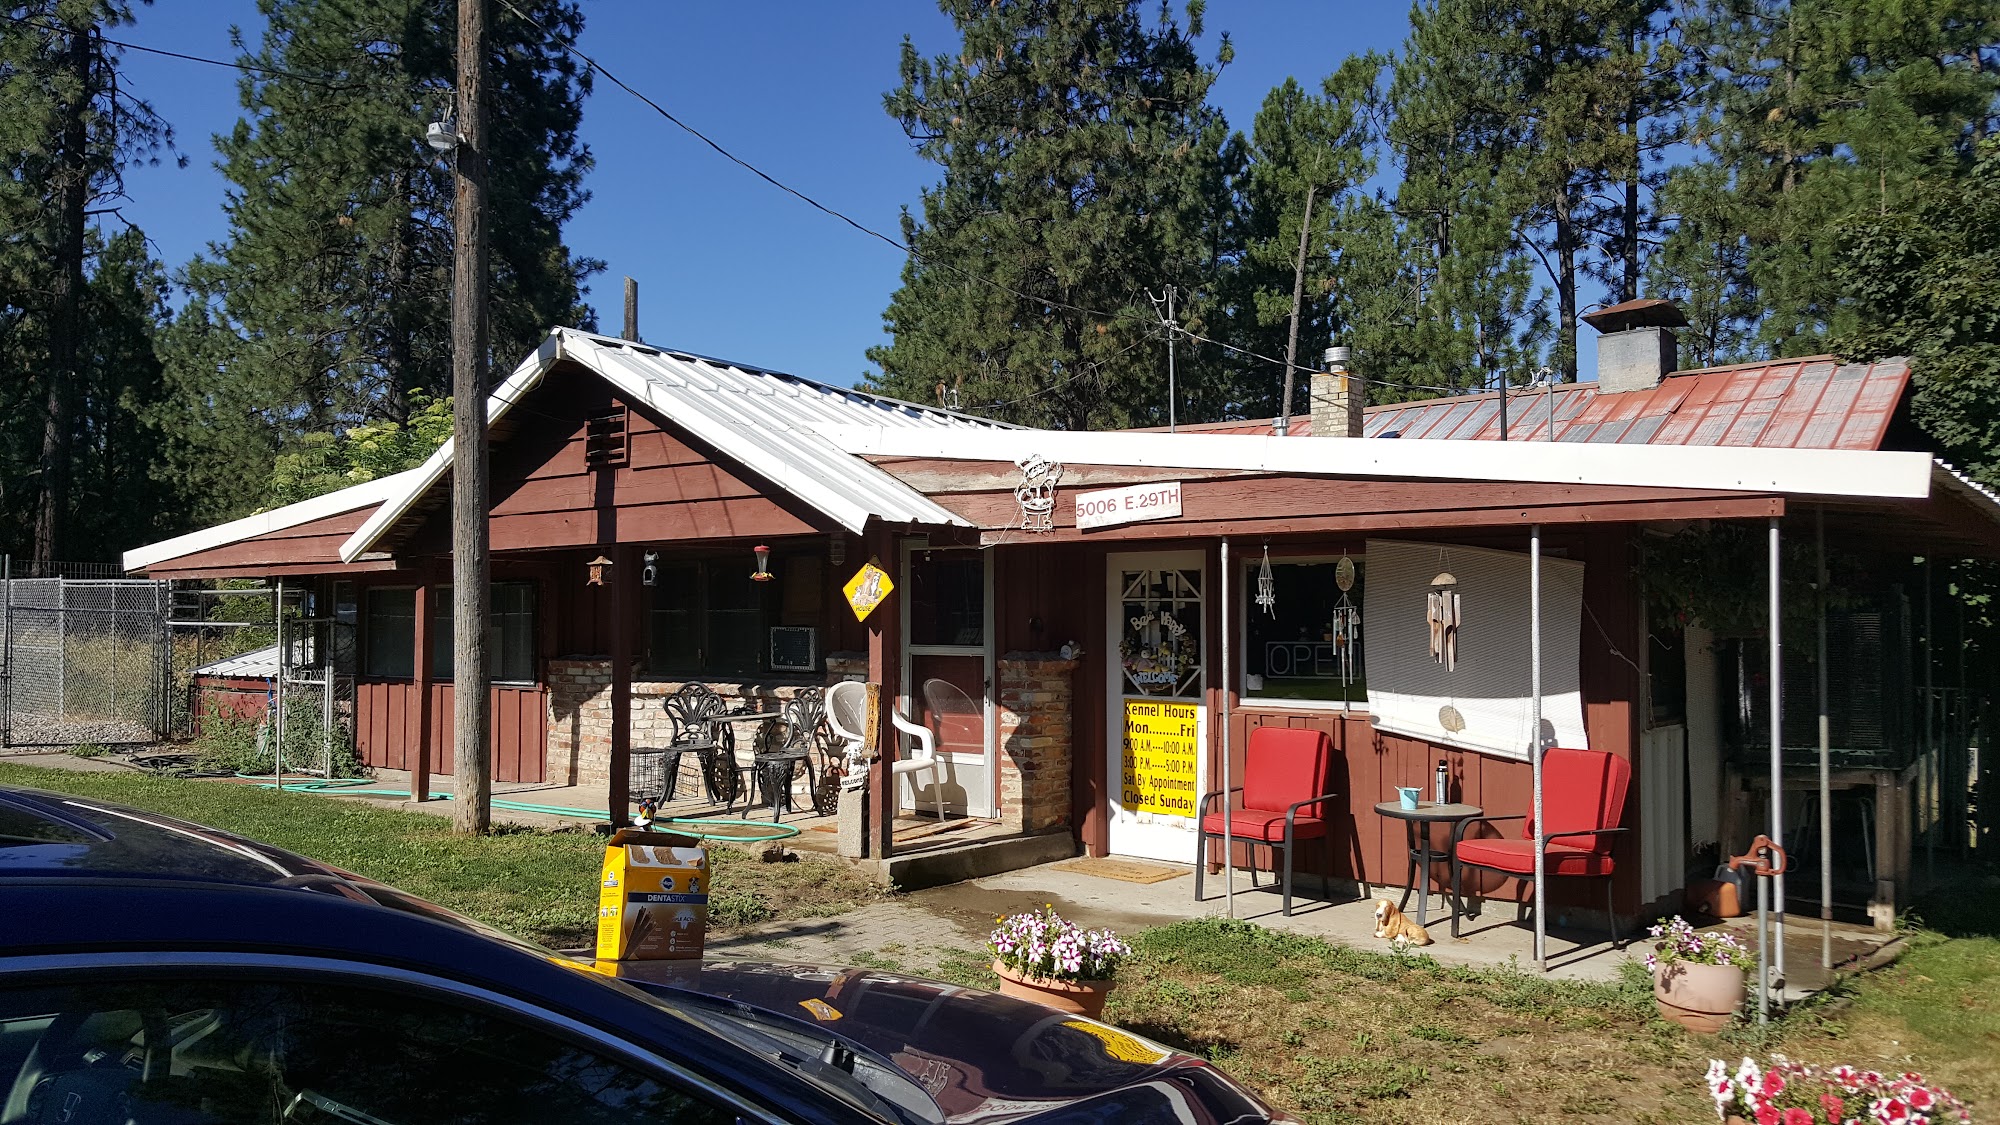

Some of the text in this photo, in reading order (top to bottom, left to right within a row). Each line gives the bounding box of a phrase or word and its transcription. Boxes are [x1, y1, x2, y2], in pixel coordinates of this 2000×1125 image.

[1076, 488, 1179, 517] 5006 E.29TH
[1160, 610, 1187, 636] Happy
[1270, 644, 1358, 676] OPEN
[1132, 671, 1179, 685] WELCOME
[1124, 702, 1195, 719] Kennel Hours
[1137, 773, 1147, 790] By
[1149, 774, 1195, 792] Appointment
[1124, 790, 1194, 814] Closed Sunday
